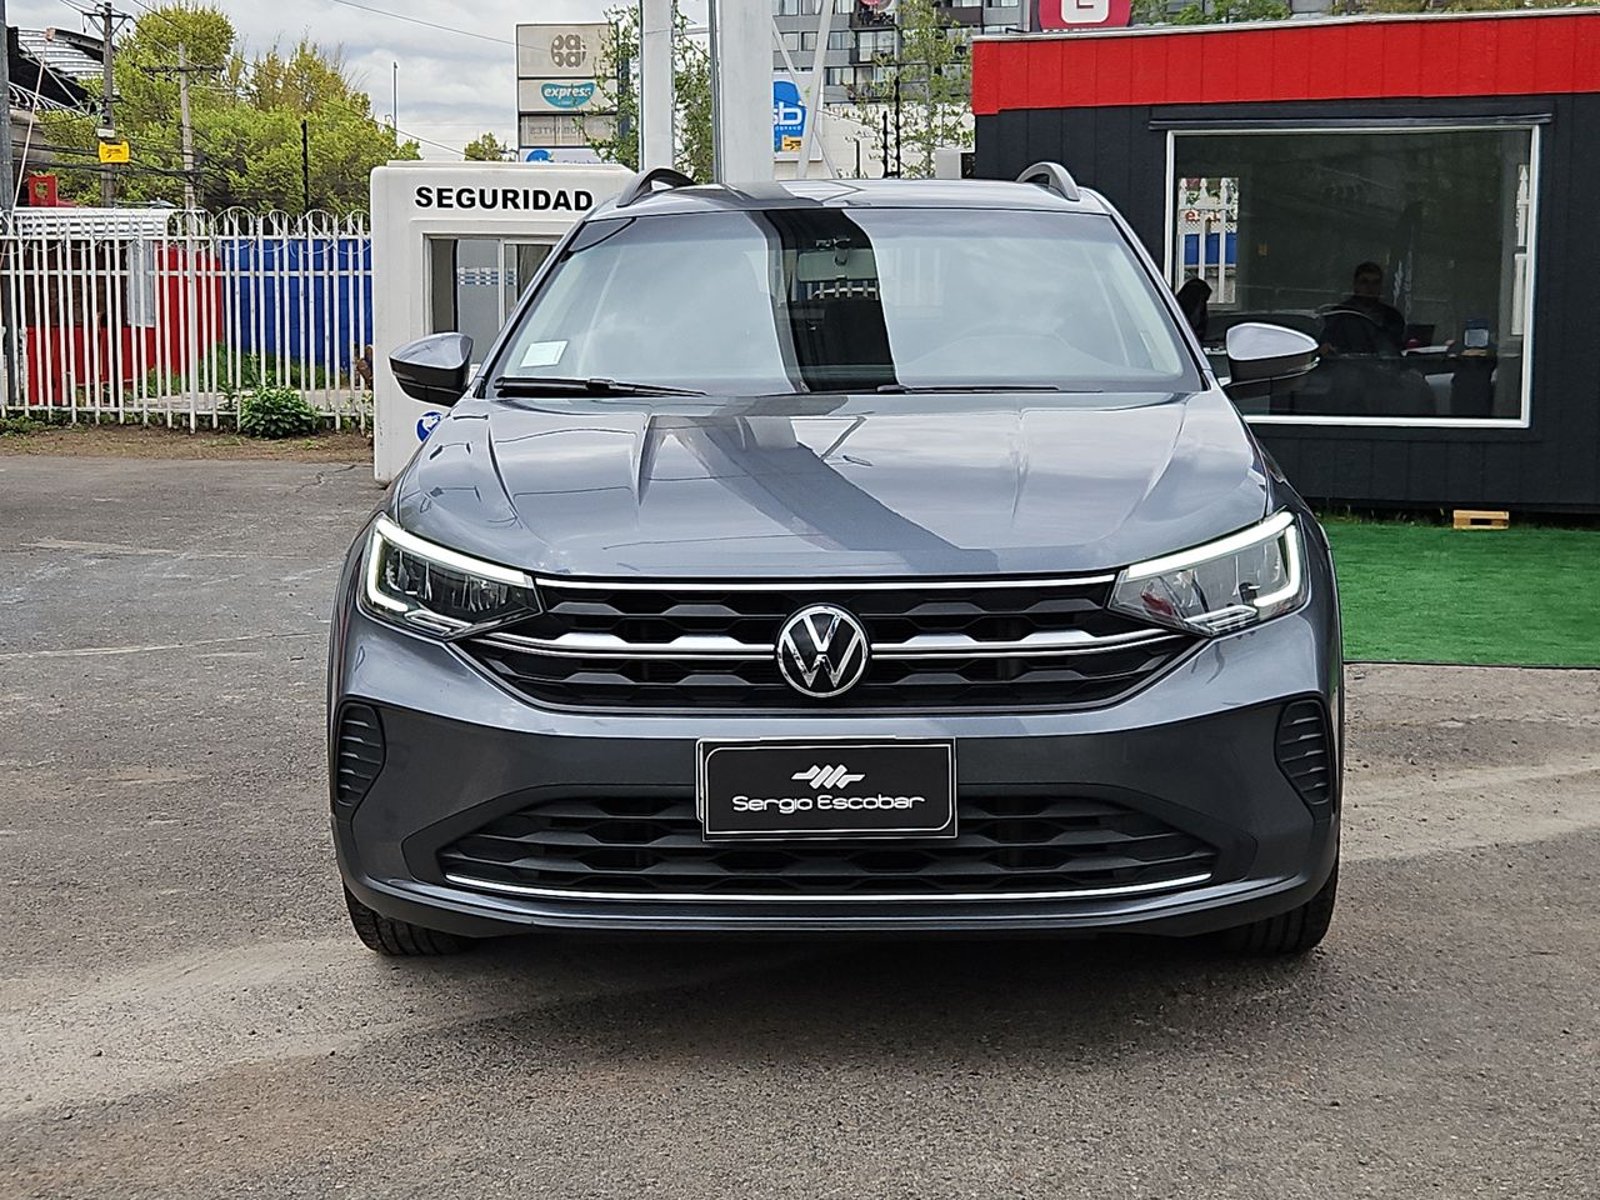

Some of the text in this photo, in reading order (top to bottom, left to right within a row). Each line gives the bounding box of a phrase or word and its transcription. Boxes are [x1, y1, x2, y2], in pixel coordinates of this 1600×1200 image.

[543, 86, 592, 100] express
[414, 186, 593, 211] SEGURIDAD
[732, 794, 926, 814] Sergio Escobar
